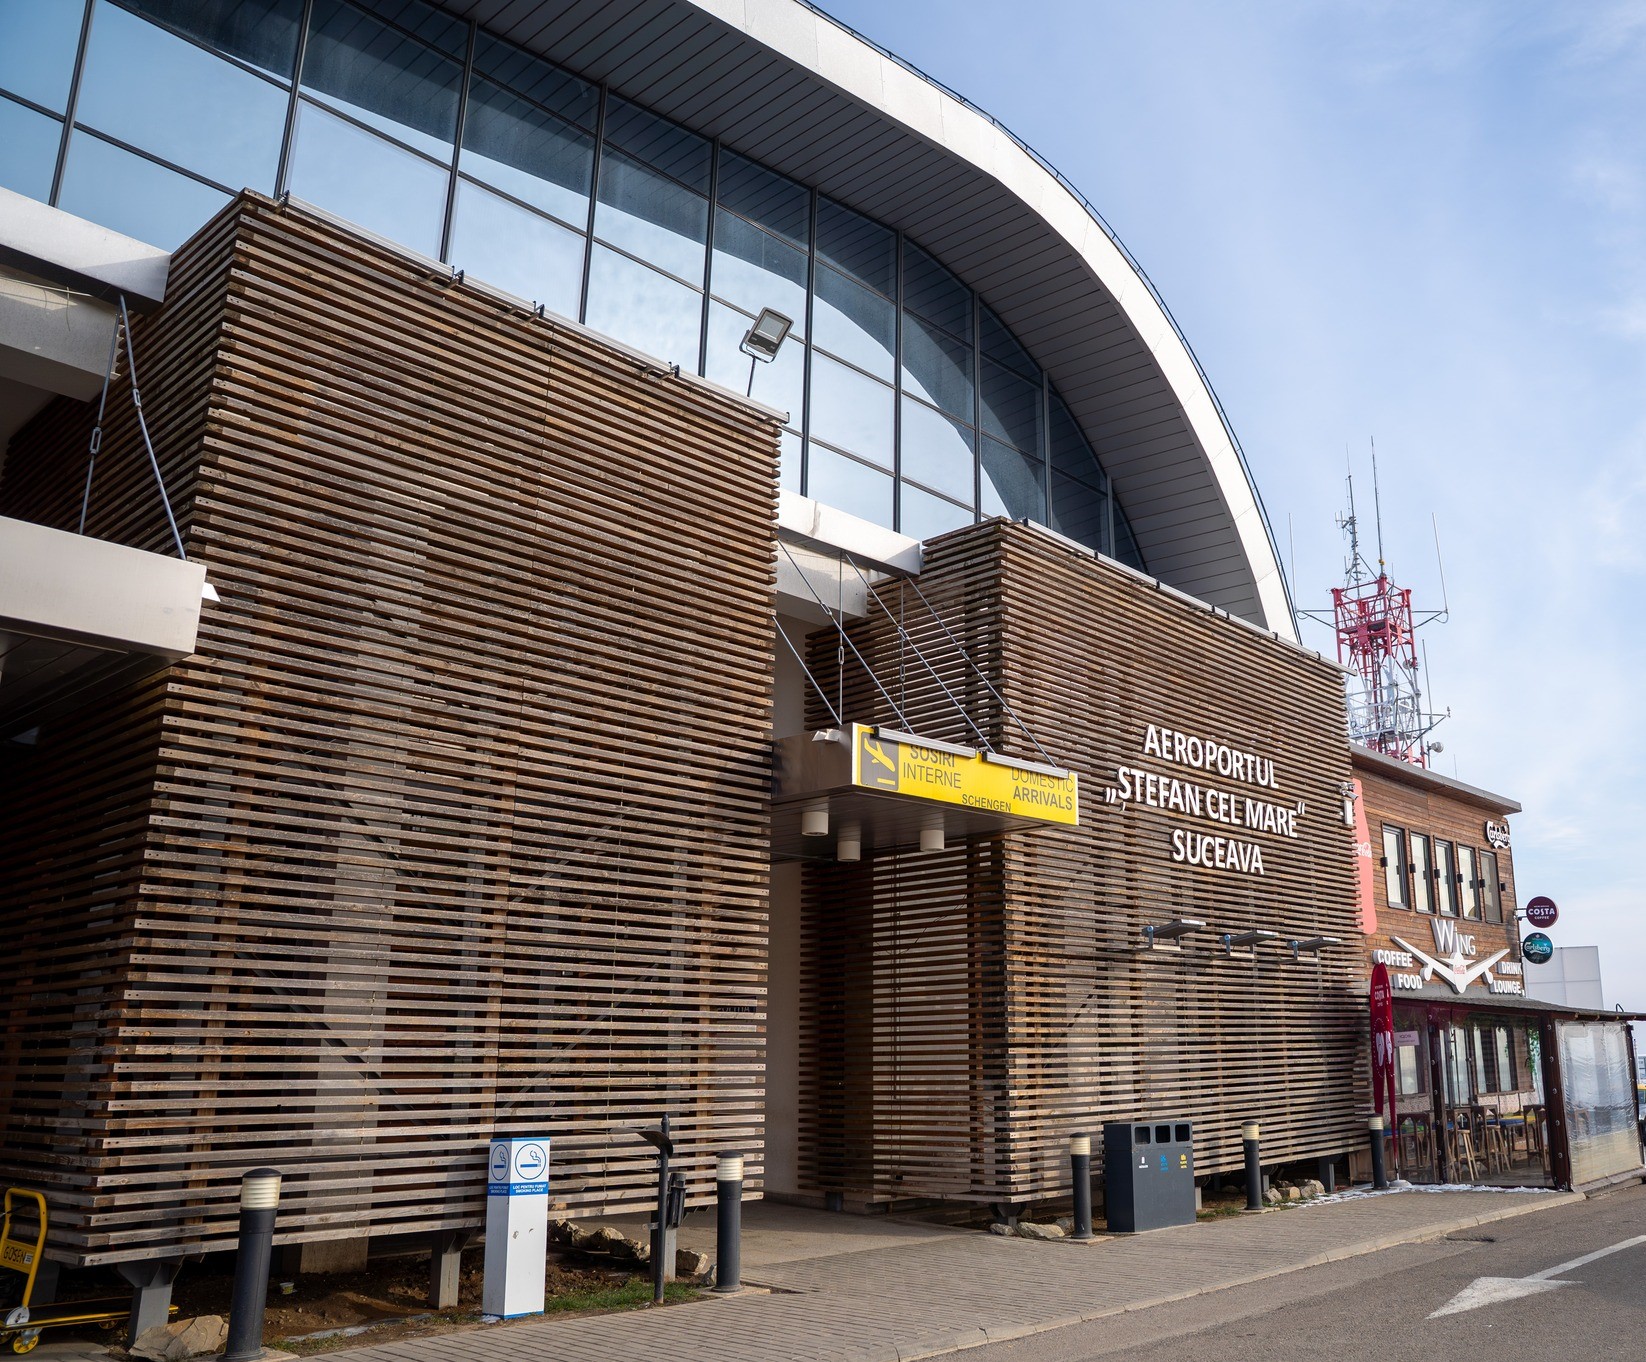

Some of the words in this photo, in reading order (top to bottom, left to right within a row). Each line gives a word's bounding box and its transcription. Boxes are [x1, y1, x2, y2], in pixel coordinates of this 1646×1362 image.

[910, 745, 955, 768] SOSIRI
[1144, 724, 1279, 789] AEROPORTUL
[903, 762, 962, 789] INTERNE
[1011, 768, 1074, 793] DOMESTIC
[961, 794, 1012, 812] SCHENGEN
[1013, 785, 1073, 811] ARRIVALS
[1205, 789, 1242, 825] CEL
[1172, 829, 1264, 875] SUCEAVA
[1528, 908, 1556, 916] COSTA
[1524, 941, 1551, 954] Carlsberg
[1376, 949, 1413, 968] COFFEE
[1500, 961, 1522, 975] DRINK
[1396, 973, 1423, 990] FOOD
[3, 1246, 27, 1265] GOSEN
